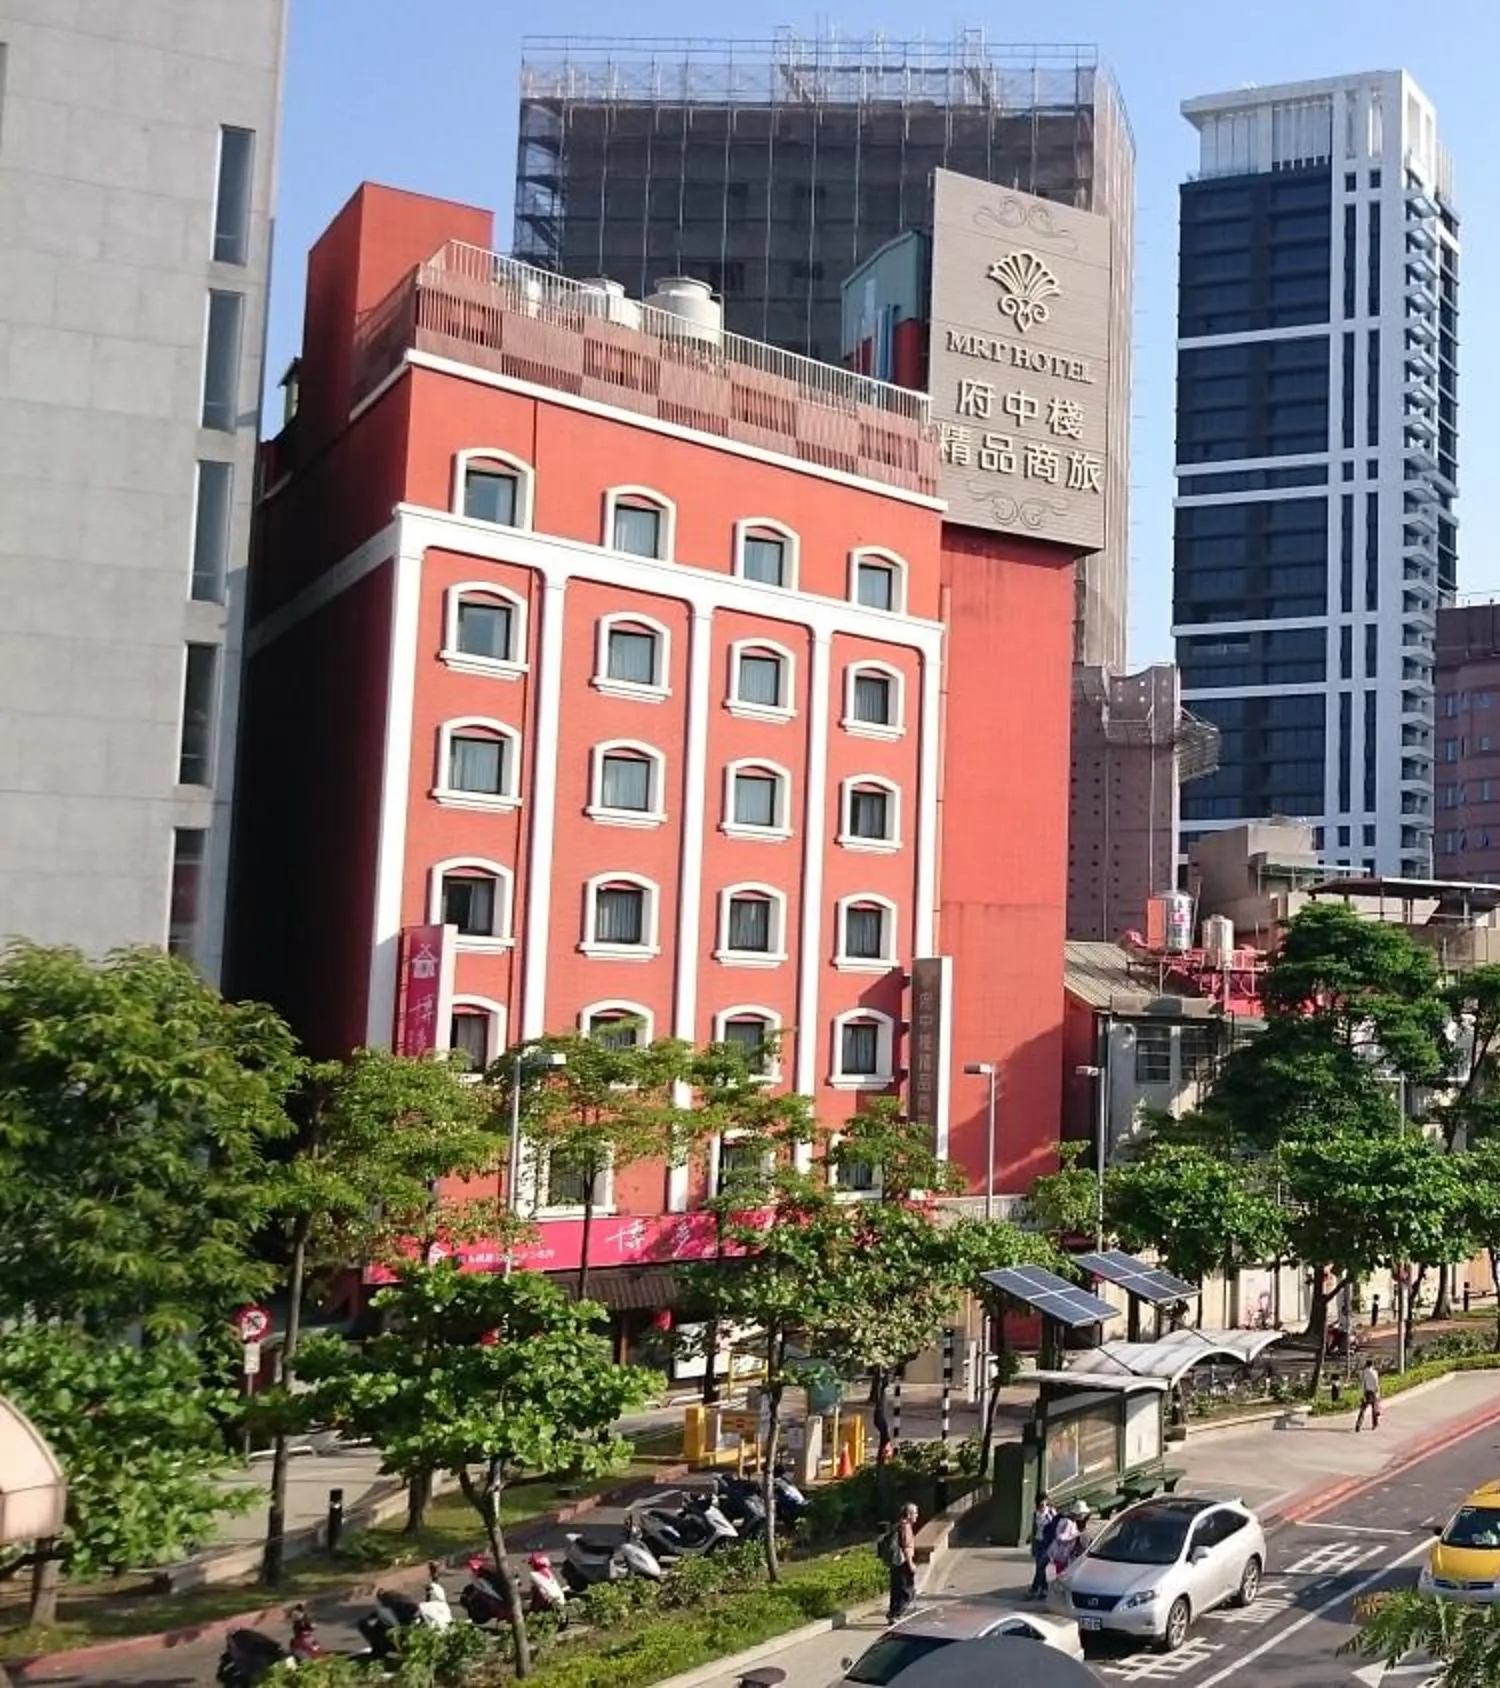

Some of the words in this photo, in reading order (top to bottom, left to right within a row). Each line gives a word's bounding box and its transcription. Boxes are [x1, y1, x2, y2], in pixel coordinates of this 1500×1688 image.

[946, 330, 1006, 362] MRT
[1010, 345, 1096, 384] HOTEL
[956, 379, 1086, 440] 府中棧
[937, 422, 1104, 495] 精品商旅
